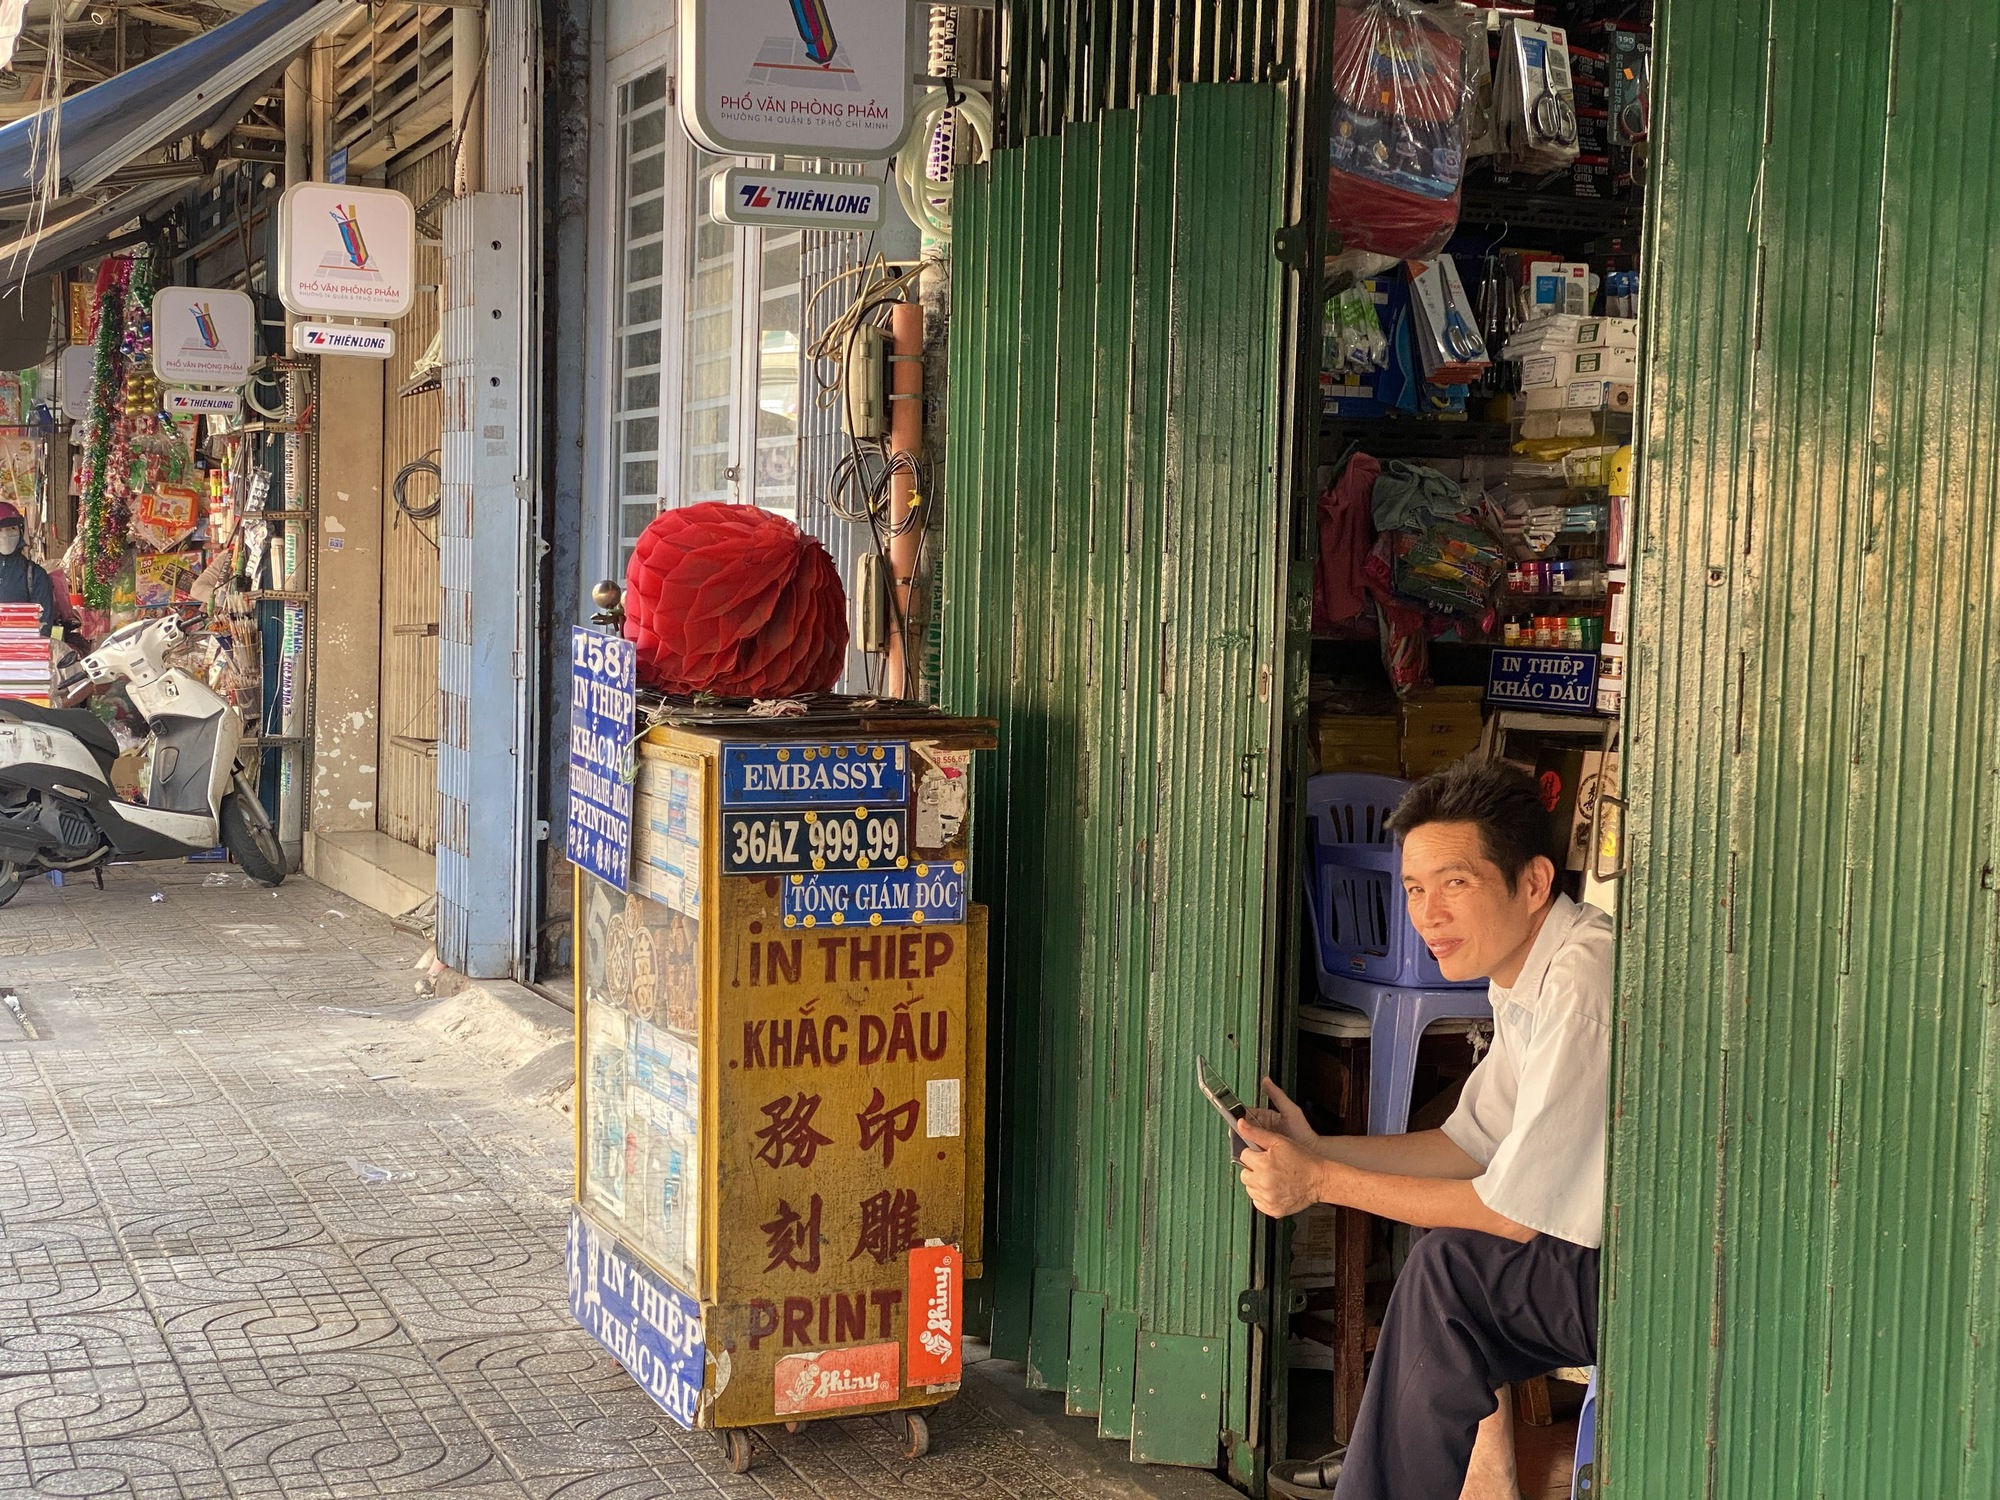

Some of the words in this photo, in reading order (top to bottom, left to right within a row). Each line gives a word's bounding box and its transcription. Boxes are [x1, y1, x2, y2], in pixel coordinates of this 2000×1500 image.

[1618, 35, 1634, 44] 190
[1614, 53, 1623, 112] SCISSORS
[720, 91, 752, 110] PHỐ
[757, 97, 786, 113] VĂN
[790, 98, 843, 117] PHÒNG
[847, 99, 888, 119] PHẨM
[720, 111, 761, 122] PHƯỜNG
[776, 115, 803, 126] QUẬN
[807, 117, 812, 125] 5
[846, 119, 861, 129] CHÍ
[864, 121, 888, 130] MINH
[776, 188, 871, 214] THIÊNLONG
[299, 280, 319, 291] PHỐ
[320, 283, 338, 292] VĂN
[340, 284, 373, 295] PHÒNG
[375, 286, 400, 297] PHẨM
[328, 334, 385, 349] THIÊNLONG
[140, 560, 151, 568] 150
[574, 631, 621, 680] 158
[1502, 656, 1522, 672] IN
[1528, 656, 1585, 679] THIỆP
[573, 675, 589, 710] IN
[590, 679, 632, 726] THIỆP
[1491, 673, 1544, 698] KHẮC
[1549, 678, 1589, 701] DẤU
[572, 717, 607, 767] KHẮC
[606, 724, 631, 774] DẤU
[743, 762, 887, 791] EMBASSY
[570, 796, 628, 848] PRINTING
[732, 819, 799, 864] 36AZ
[809, 818, 899, 862] 999.99
[791, 874, 849, 912] TỔNG
[855, 876, 910, 910] GIÁM
[916, 869, 959, 908] ĐỐC
[818, 926, 954, 991] THIỆP
[744, 997, 848, 1071] KHẮC
[859, 996, 948, 1066] DẤU
[602, 1252, 627, 1298] IN
[629, 1270, 703, 1358] THIỆP
[750, 1289, 902, 1351] PRINT
[927, 1266, 952, 1332] Shiny
[601, 1306, 650, 1384] KHẮC
[650, 1352, 699, 1424] DẤU
[813, 1367, 881, 1398] Shiny
